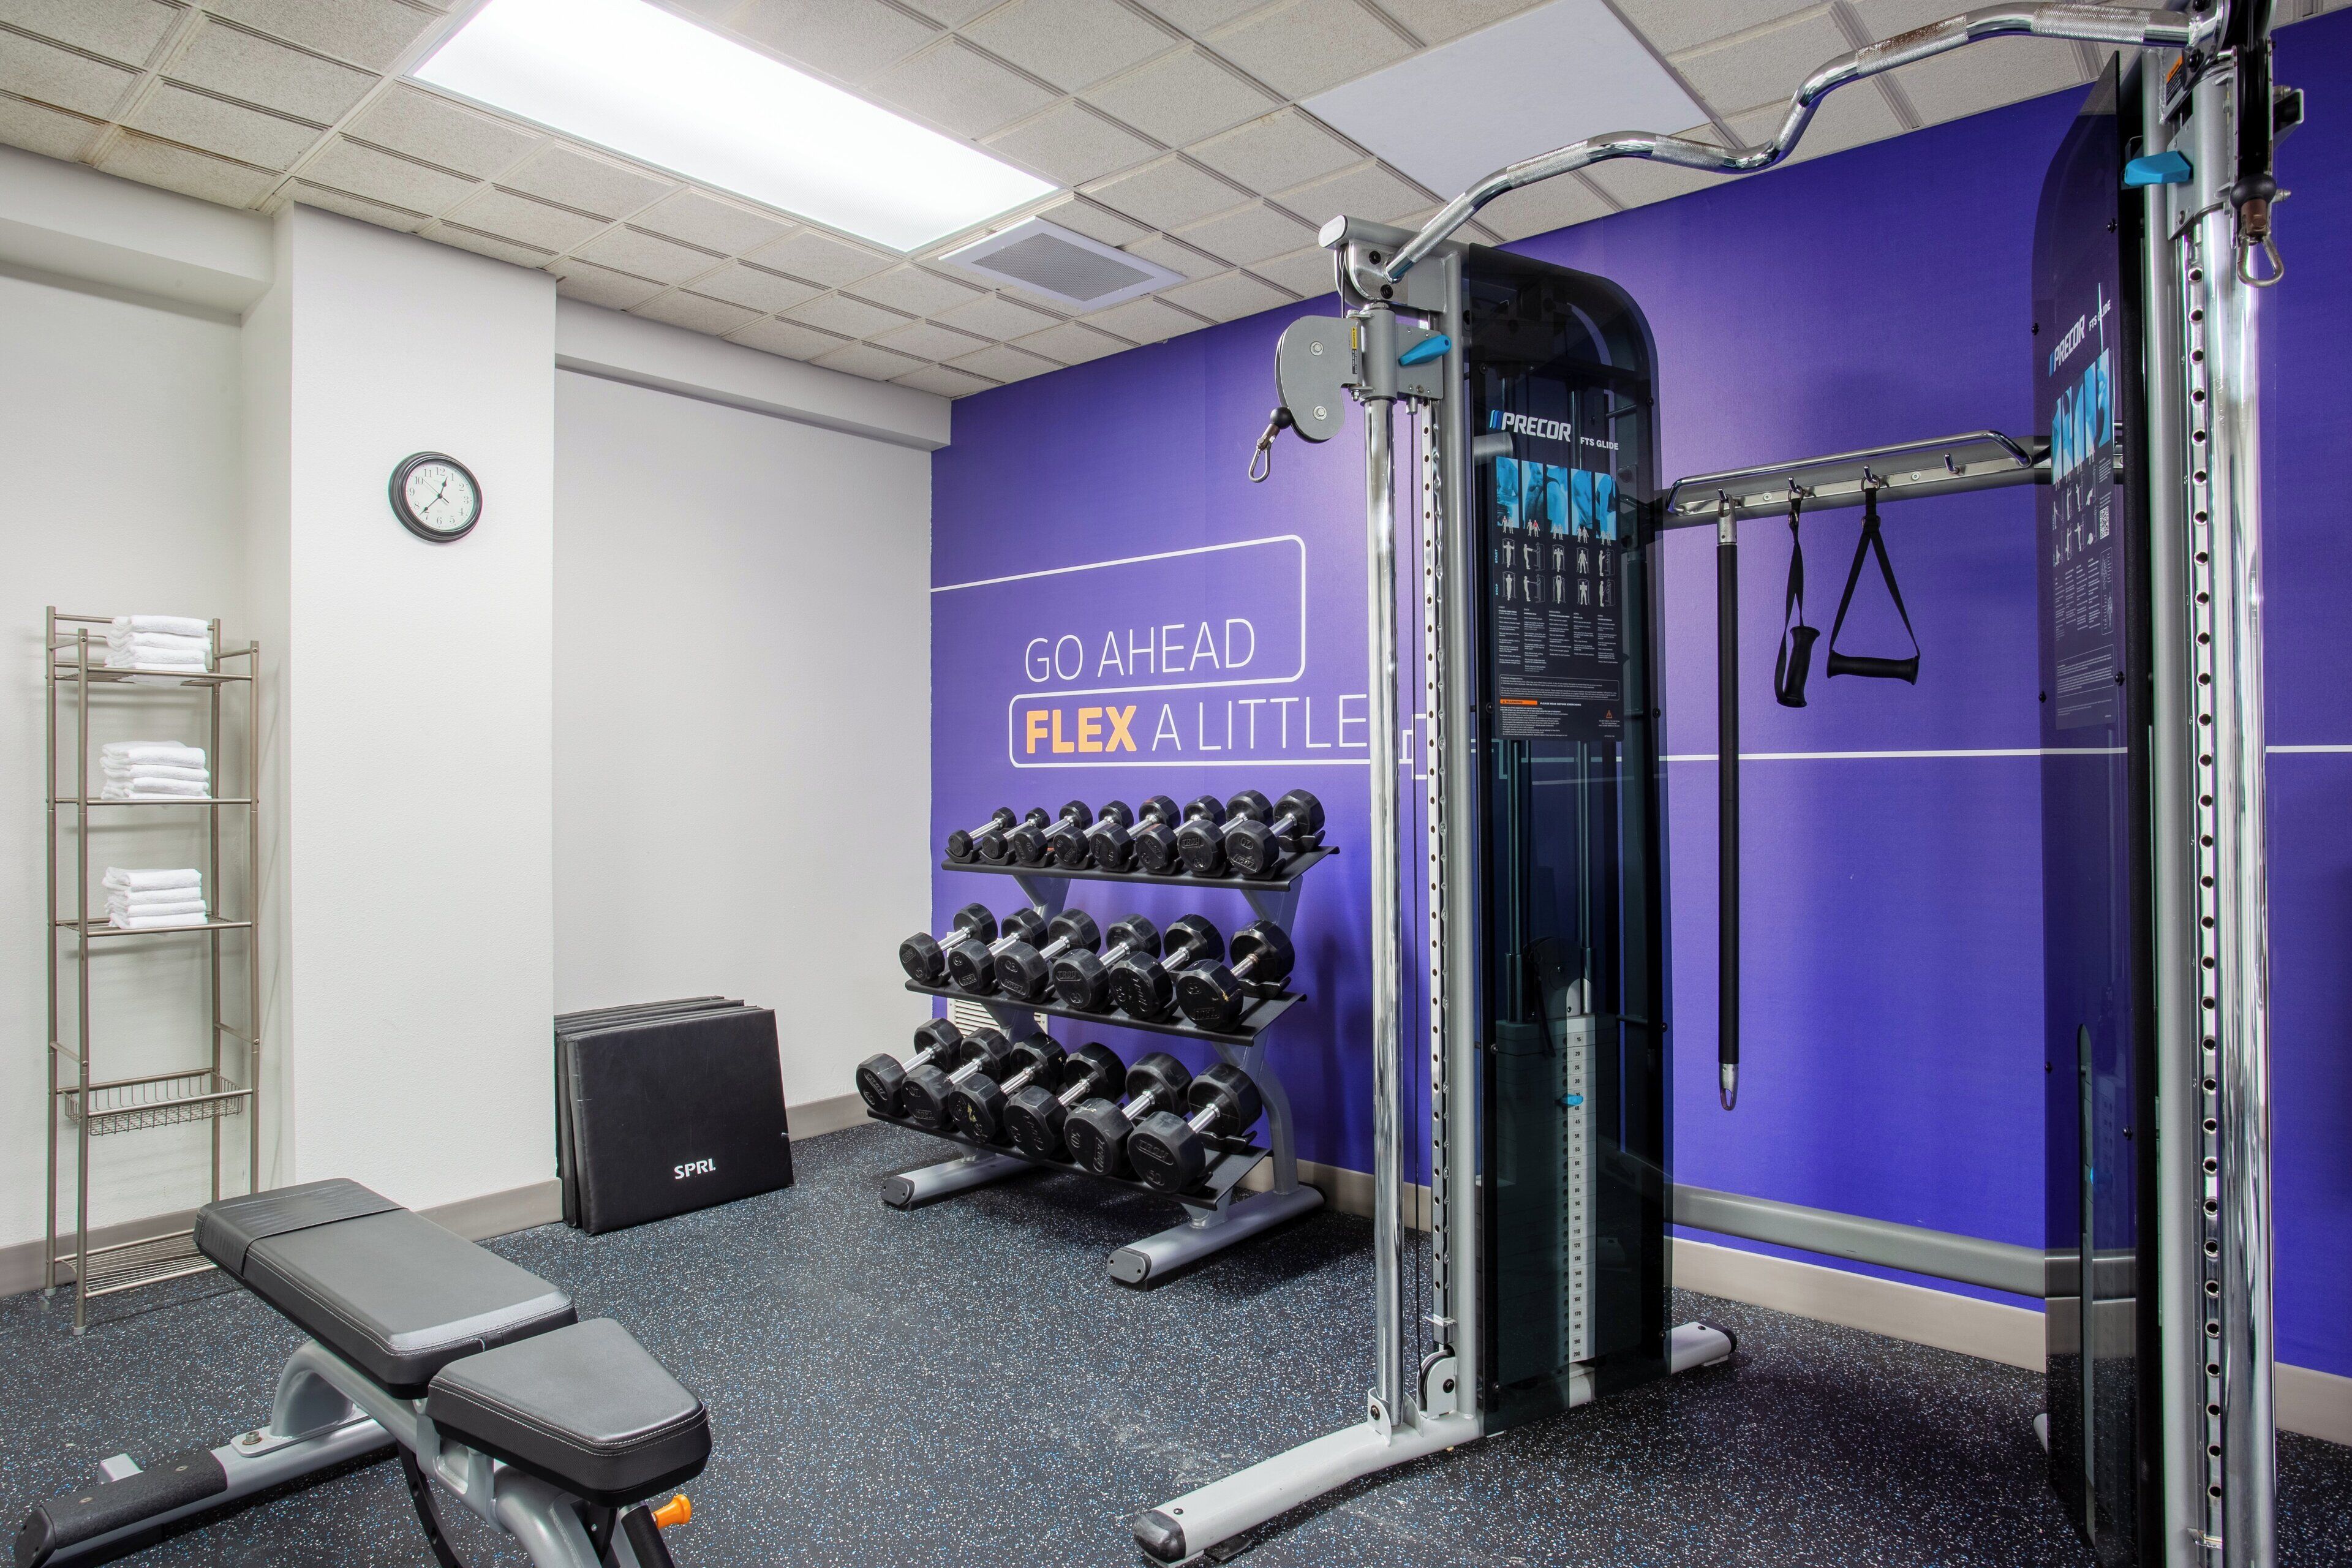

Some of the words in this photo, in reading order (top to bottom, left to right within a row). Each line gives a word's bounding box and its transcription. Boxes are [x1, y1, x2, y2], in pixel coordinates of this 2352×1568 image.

[2089, 315, 2097, 331] FTS
[2054, 314, 2085, 372] PRECOR
[1501, 412, 1571, 442] PRECOR
[1580, 437, 1594, 447] FTS
[1596, 440, 1619, 450] GLIDE
[424, 469, 431, 477] 11
[436, 467, 445, 476] 12
[415, 477, 423, 485] 10
[414, 501, 420, 510] 8
[437, 516, 442, 525] 6
[450, 515, 454, 524] 5
[1025, 635, 1083, 682] GO
[1098, 618, 1254, 677] AHEAD
[1027, 705, 1137, 753] FLEX
[1152, 704, 1181, 751] A
[1199, 694, 1367, 750] LITTLE
